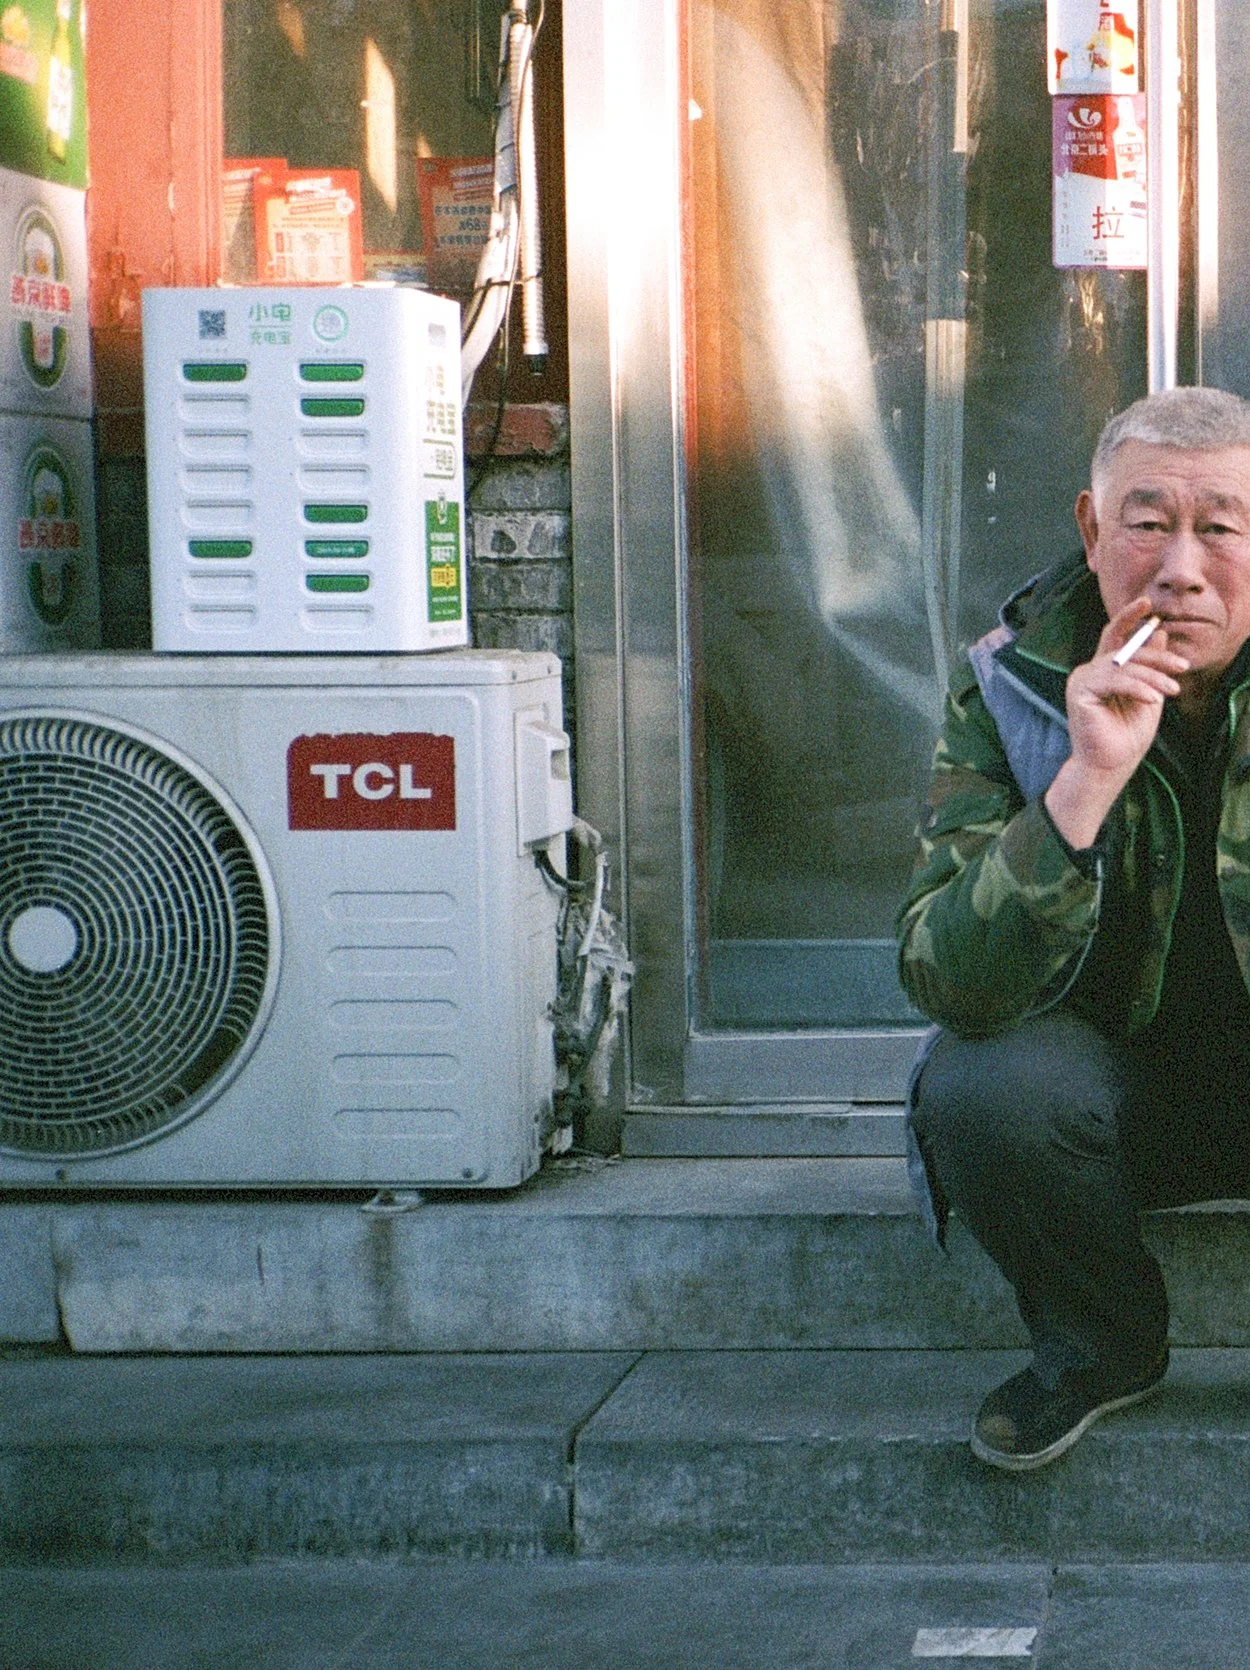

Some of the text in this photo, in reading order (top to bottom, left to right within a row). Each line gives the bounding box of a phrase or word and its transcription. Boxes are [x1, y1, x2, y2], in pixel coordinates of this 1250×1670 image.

[1091, 205, 1125, 240] 拉
[249, 302, 291, 321] 小电
[251, 331, 291, 345] 充电宝
[310, 762, 432, 801] TCL
